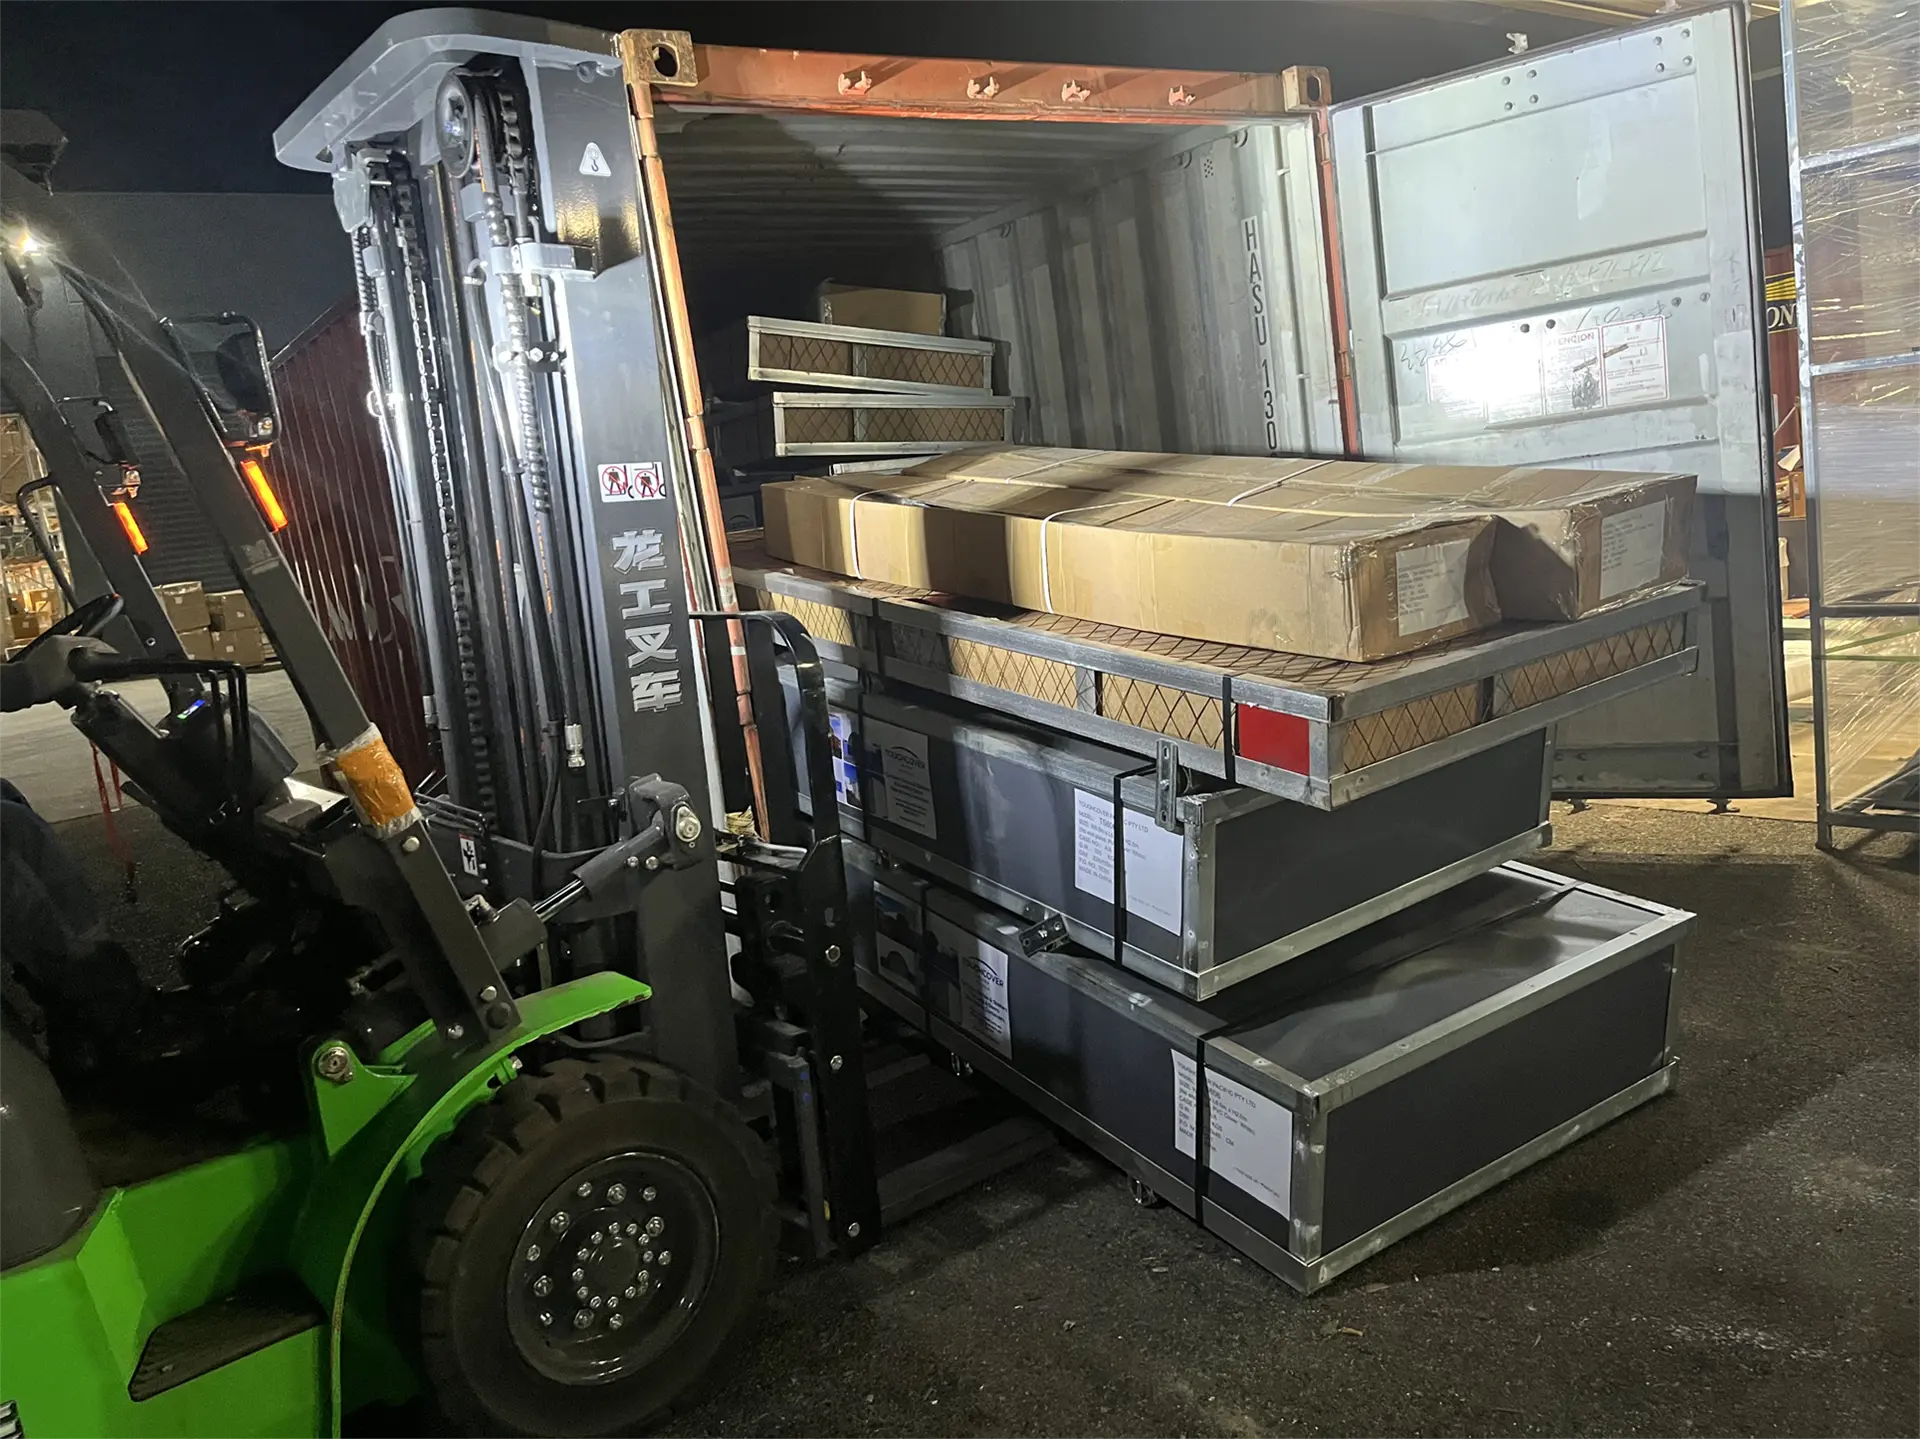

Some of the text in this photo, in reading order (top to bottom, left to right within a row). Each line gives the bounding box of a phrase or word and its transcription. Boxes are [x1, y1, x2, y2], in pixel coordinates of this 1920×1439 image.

[1243, 218, 1267, 347] HASU
[612, 528, 684, 714] 龙工叉车
